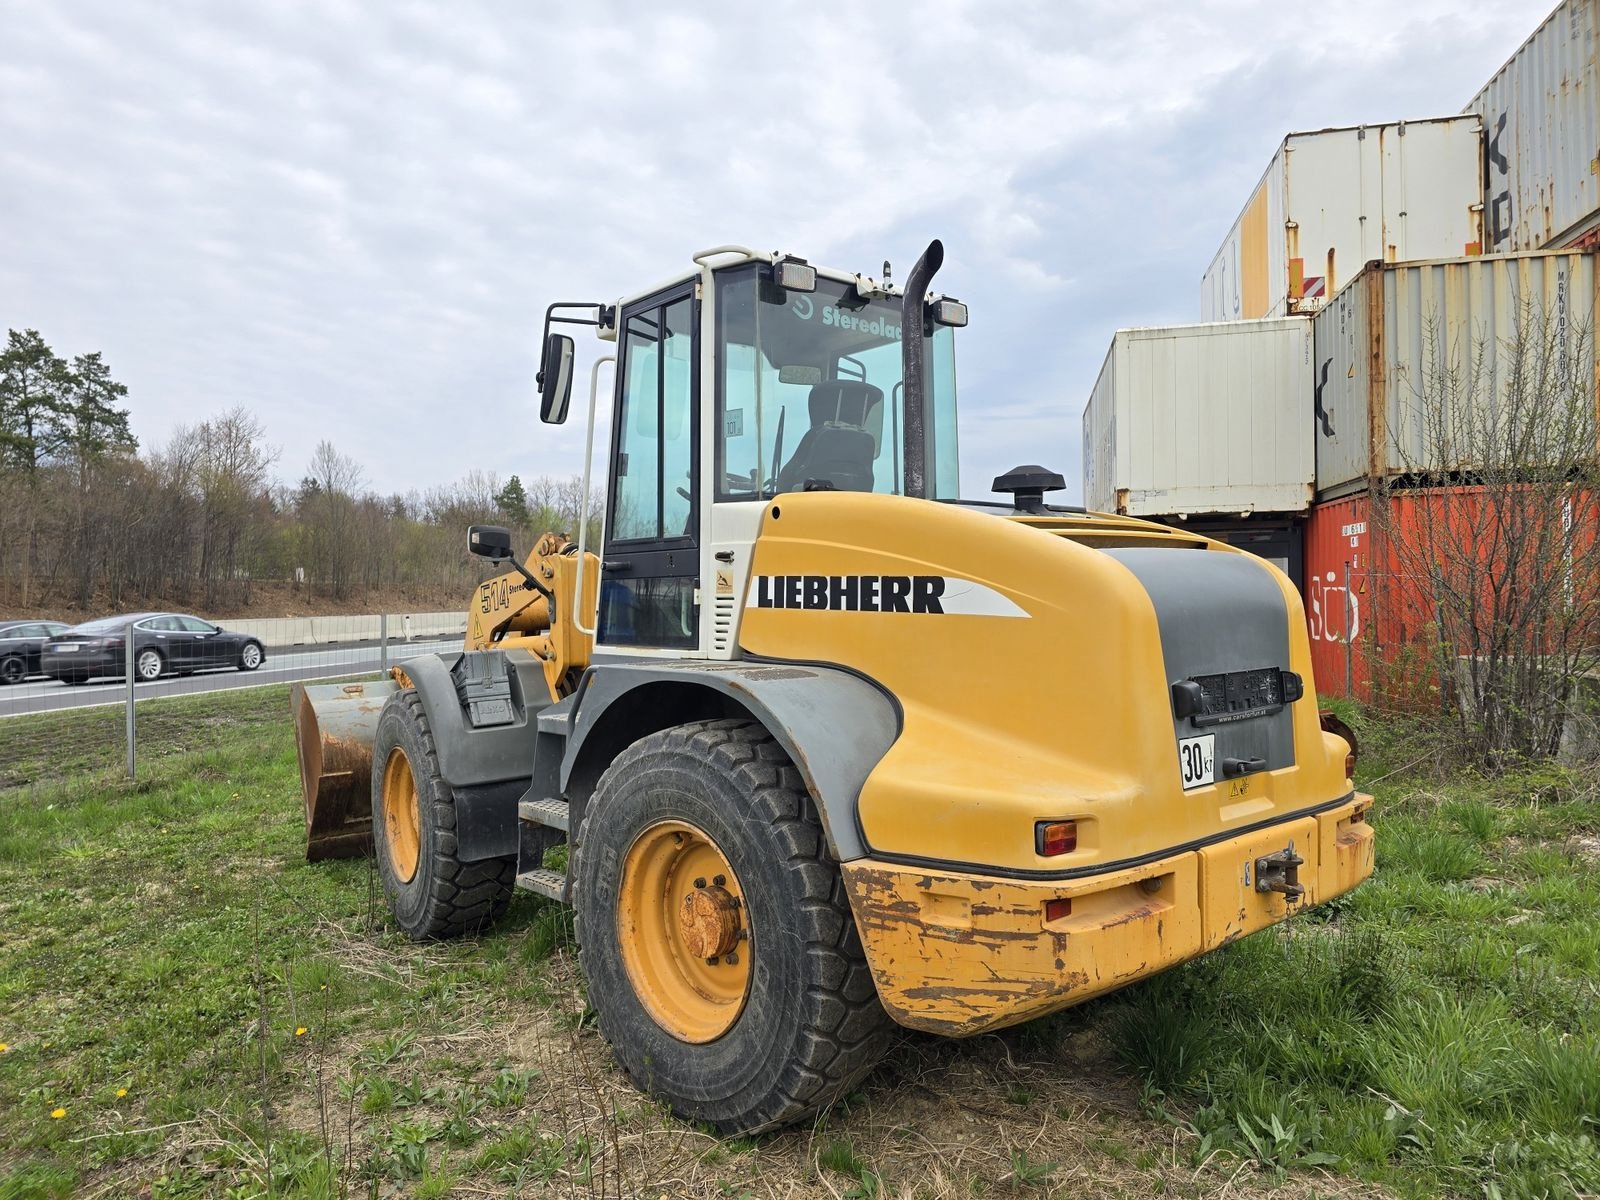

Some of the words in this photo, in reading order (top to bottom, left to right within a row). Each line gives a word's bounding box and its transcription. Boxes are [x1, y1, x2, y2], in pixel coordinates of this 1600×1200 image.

[481, 578, 509, 614] 514
[757, 575, 945, 614] LIEBHERR
[1182, 743, 1203, 783] 30
